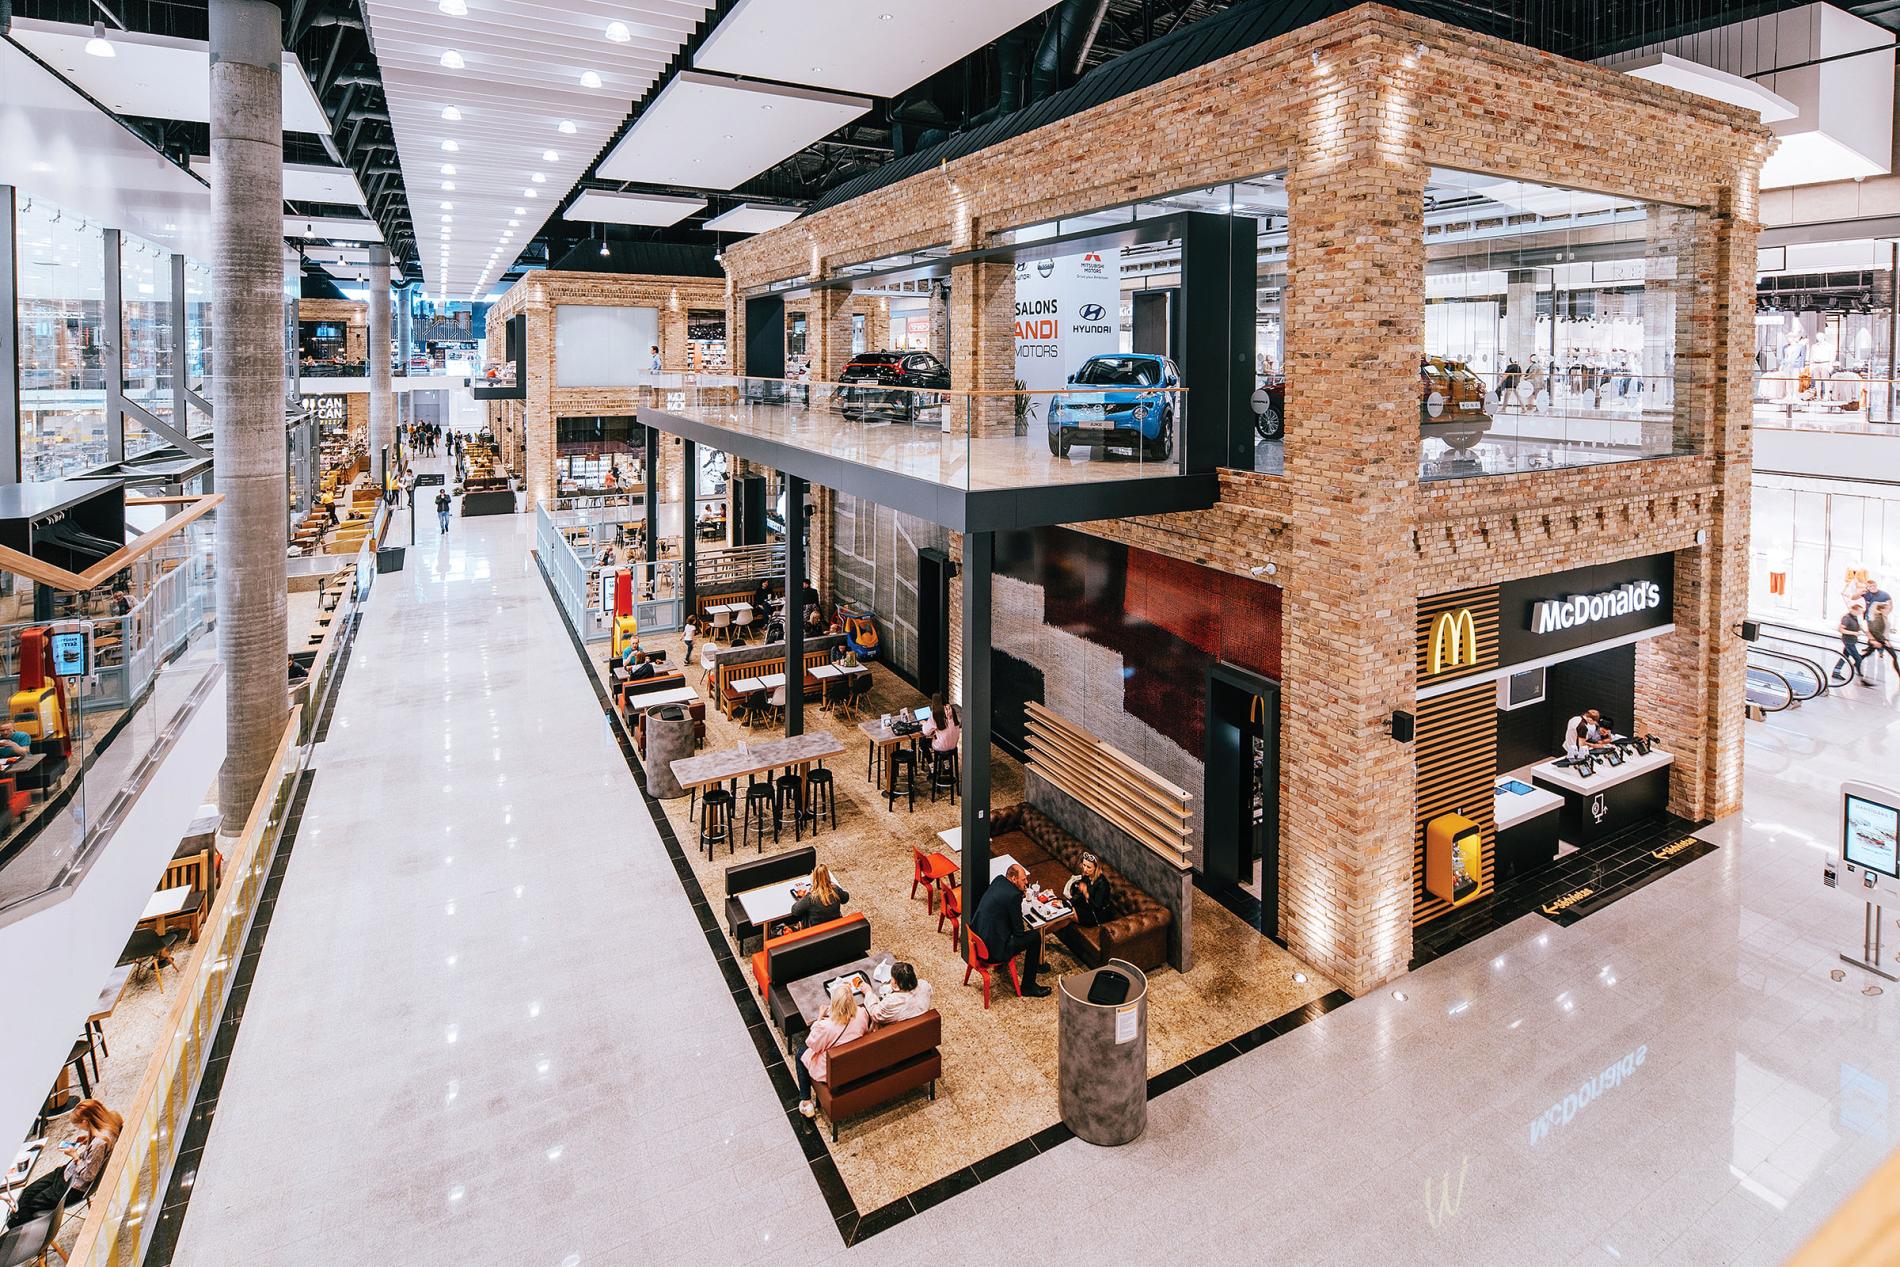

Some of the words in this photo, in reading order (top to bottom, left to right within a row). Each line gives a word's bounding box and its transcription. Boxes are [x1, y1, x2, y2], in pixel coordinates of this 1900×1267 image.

[1073, 325, 1112, 334] HYUNDAI
[318, 398, 343, 408] CAN
[318, 408, 343, 419] CAN
[1532, 581, 1661, 634] McDonald's
